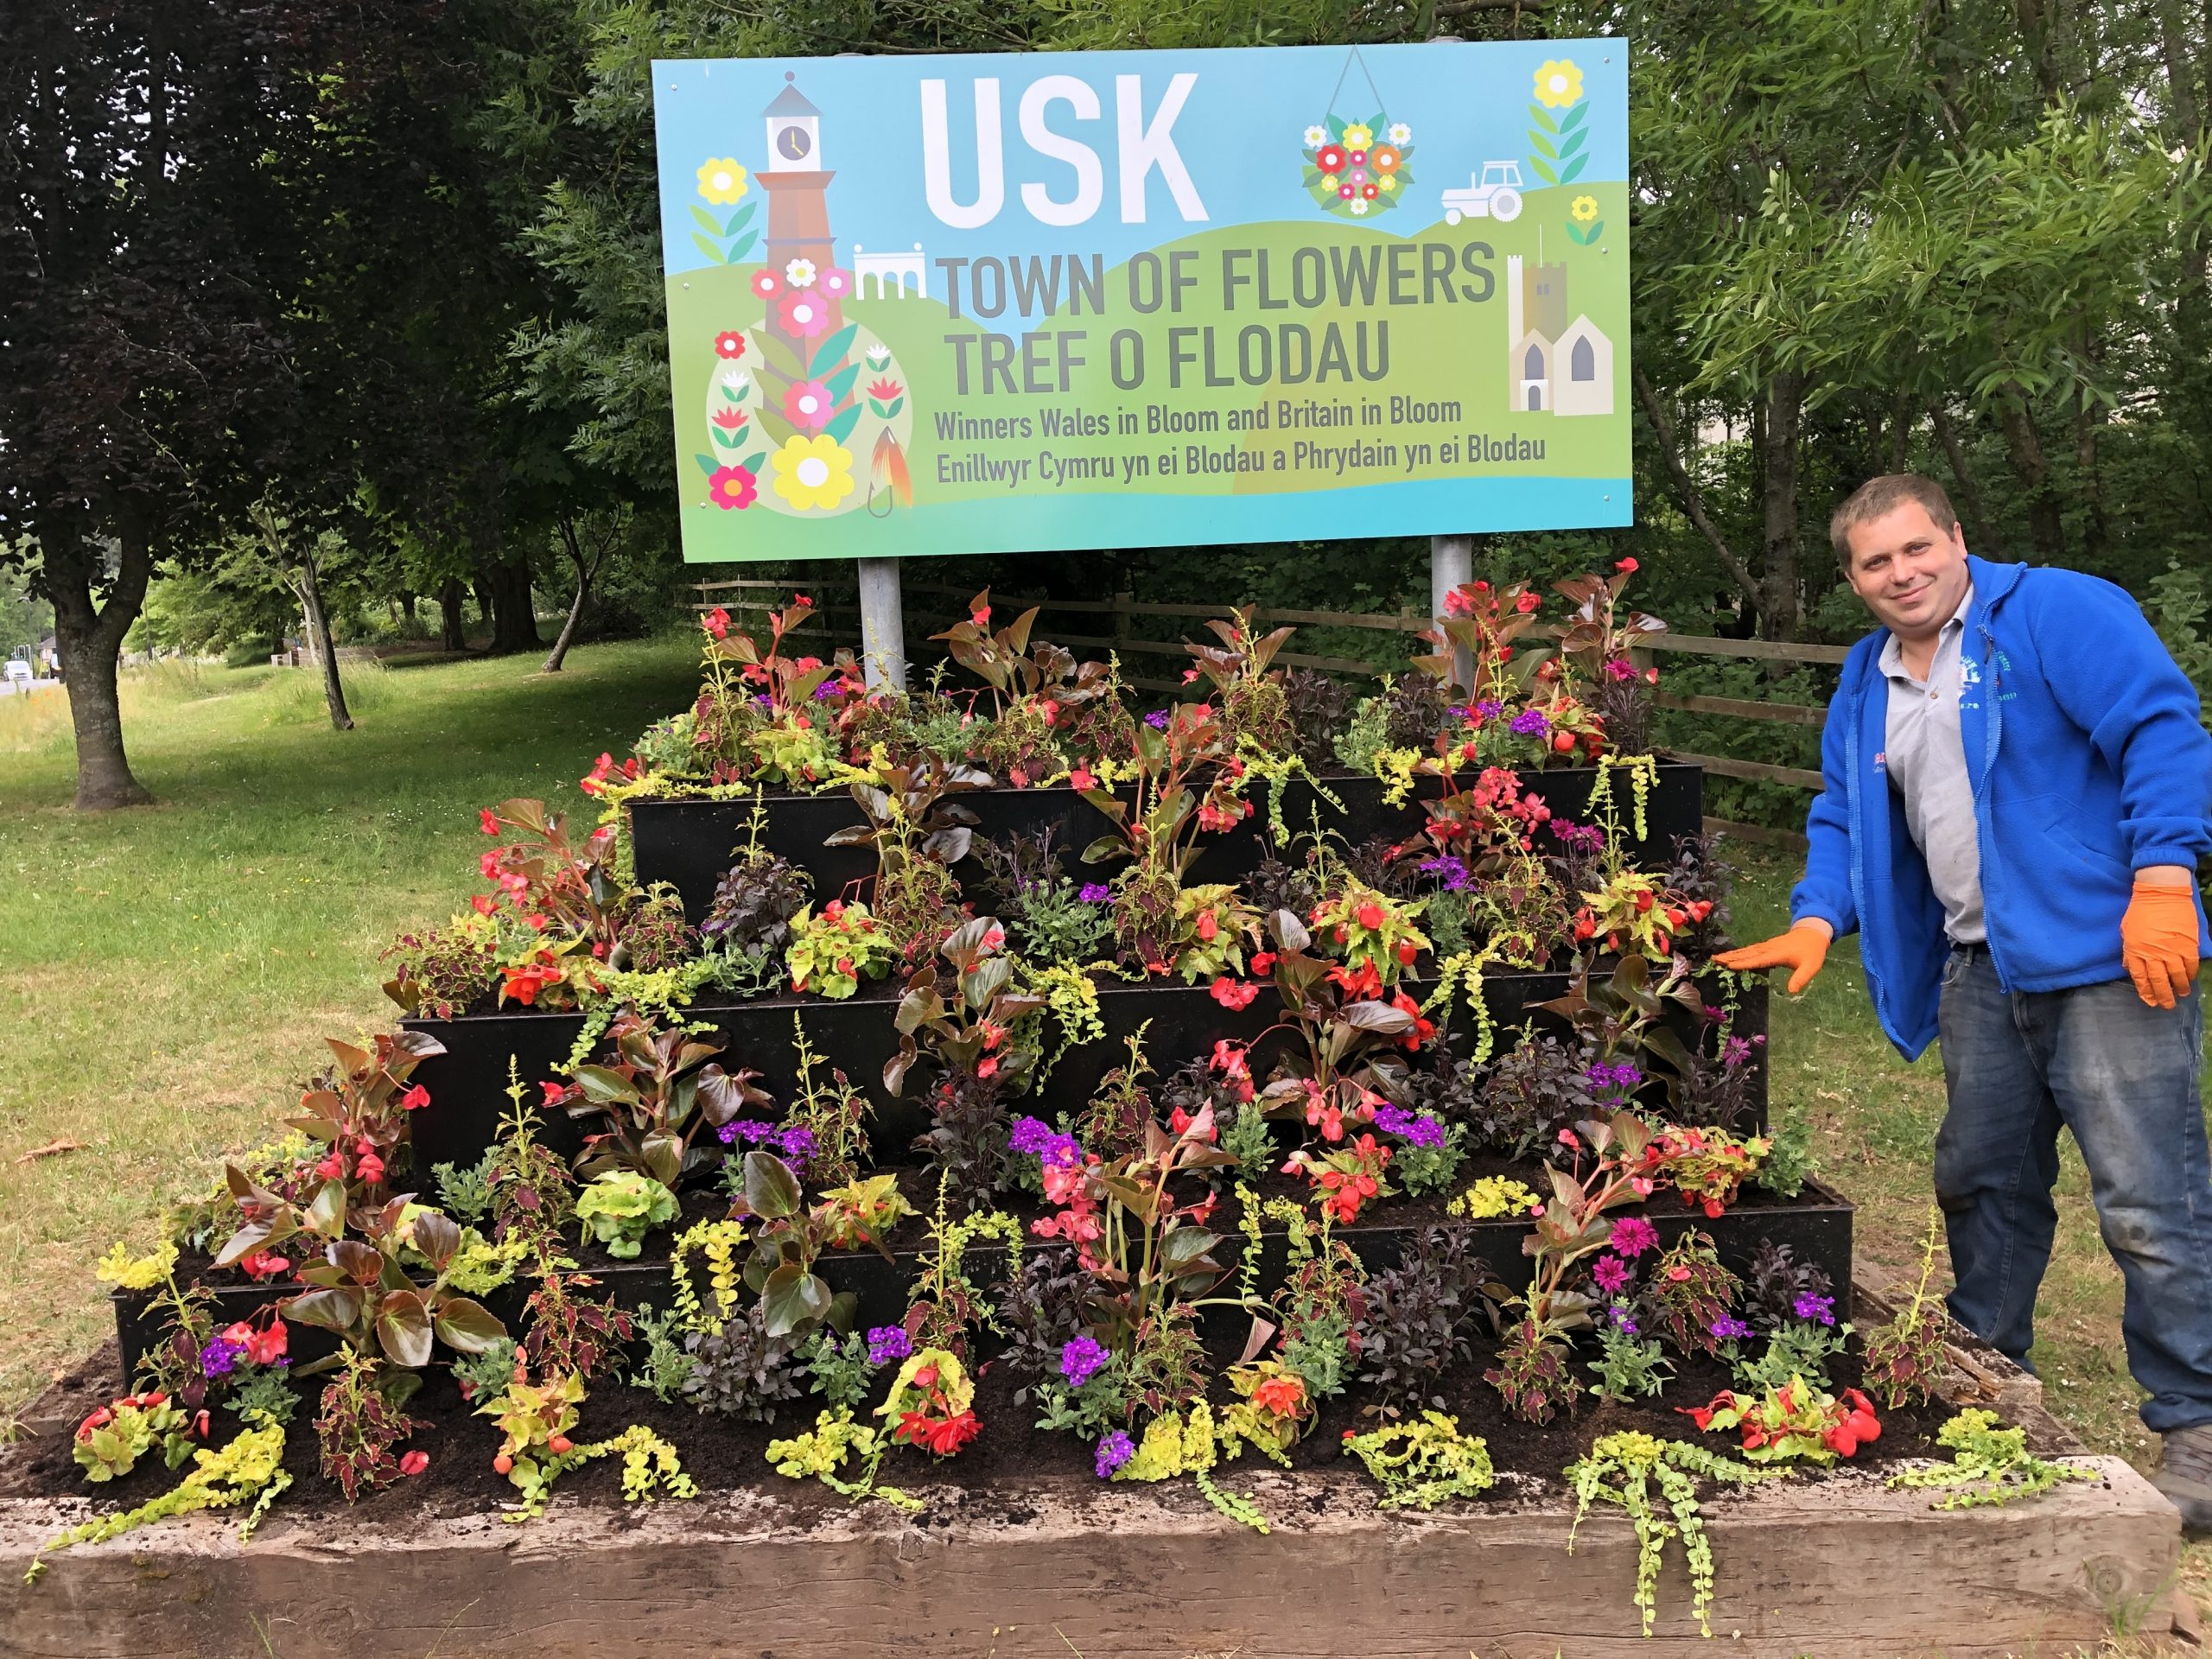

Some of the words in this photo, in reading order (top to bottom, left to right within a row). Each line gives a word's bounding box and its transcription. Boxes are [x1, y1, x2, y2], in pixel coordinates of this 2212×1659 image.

[920, 73, 1210, 229] USK
[935, 253, 1105, 319] TOWN
[1128, 251, 1199, 315] OF
[1222, 241, 1496, 311] FLOWERS
[944, 331, 1088, 395] TREF
[1110, 328, 1144, 390] O
[1168, 321, 1389, 389] FLODAU
[934, 411, 1032, 441] Winners
[1039, 408, 1109, 437] Wales
[1118, 406, 1138, 435] in
[1147, 404, 1219, 433] Bloom
[1227, 400, 1269, 430] and
[1278, 398, 1353, 429] Britain
[1362, 397, 1382, 425] in
[1390, 395, 1461, 424] Bloom
[937, 453, 1032, 488] Enillwyr
[1039, 451, 1114, 486] Cymru
[1122, 450, 1149, 484] yn
[1158, 447, 1178, 475] ei
[1185, 444, 1265, 474] Blodau
[1273, 449, 1286, 471] a
[1294, 438, 1396, 475] Phrydain
[1404, 442, 1432, 473] yn
[1440, 435, 1459, 463] ei
[1468, 433, 1546, 462] Blodau
